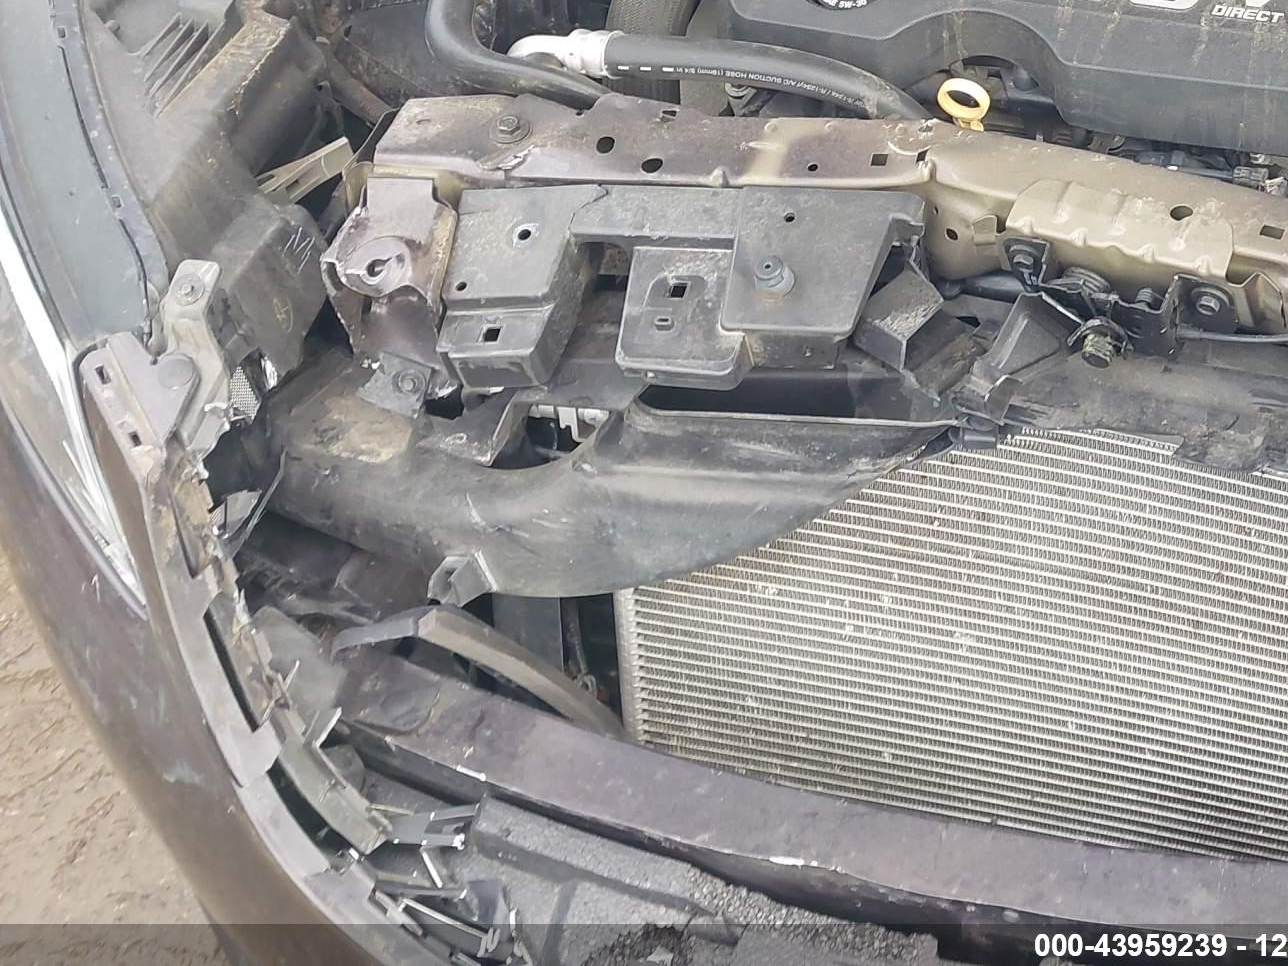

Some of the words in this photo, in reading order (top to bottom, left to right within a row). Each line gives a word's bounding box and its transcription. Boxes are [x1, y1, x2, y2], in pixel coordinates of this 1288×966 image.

[1211, 3, 1285, 24] DIRECT
[725, 70, 747, 79] HOSE
[748, 73, 782, 84] SUCTION
